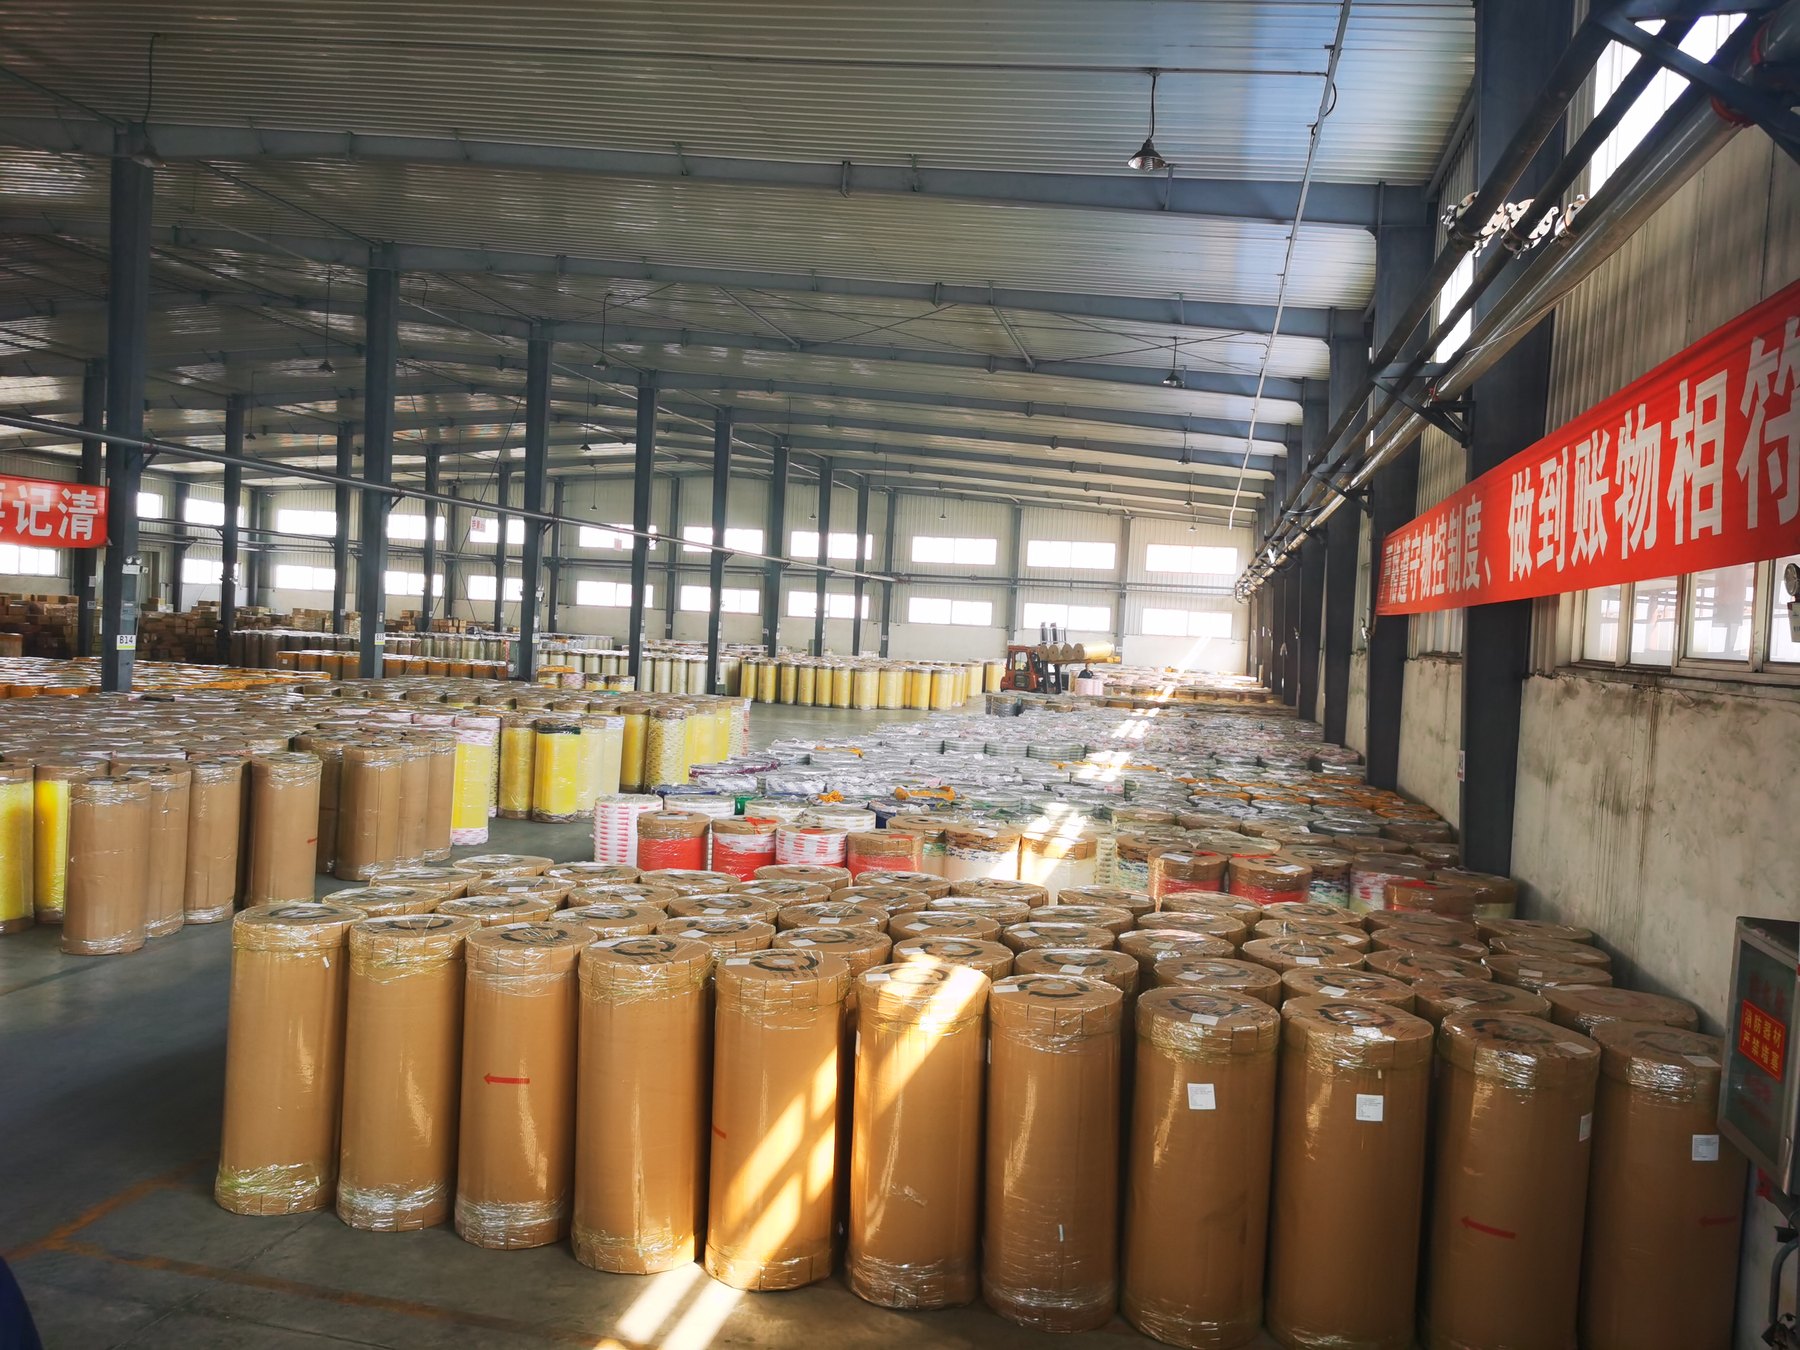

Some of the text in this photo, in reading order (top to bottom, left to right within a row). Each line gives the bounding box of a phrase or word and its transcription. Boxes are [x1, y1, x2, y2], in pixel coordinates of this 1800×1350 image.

[0, 483, 98, 540] 记清
[119, 635, 134, 644] B14
[1745, 1008, 1781, 1048] 消防器材
